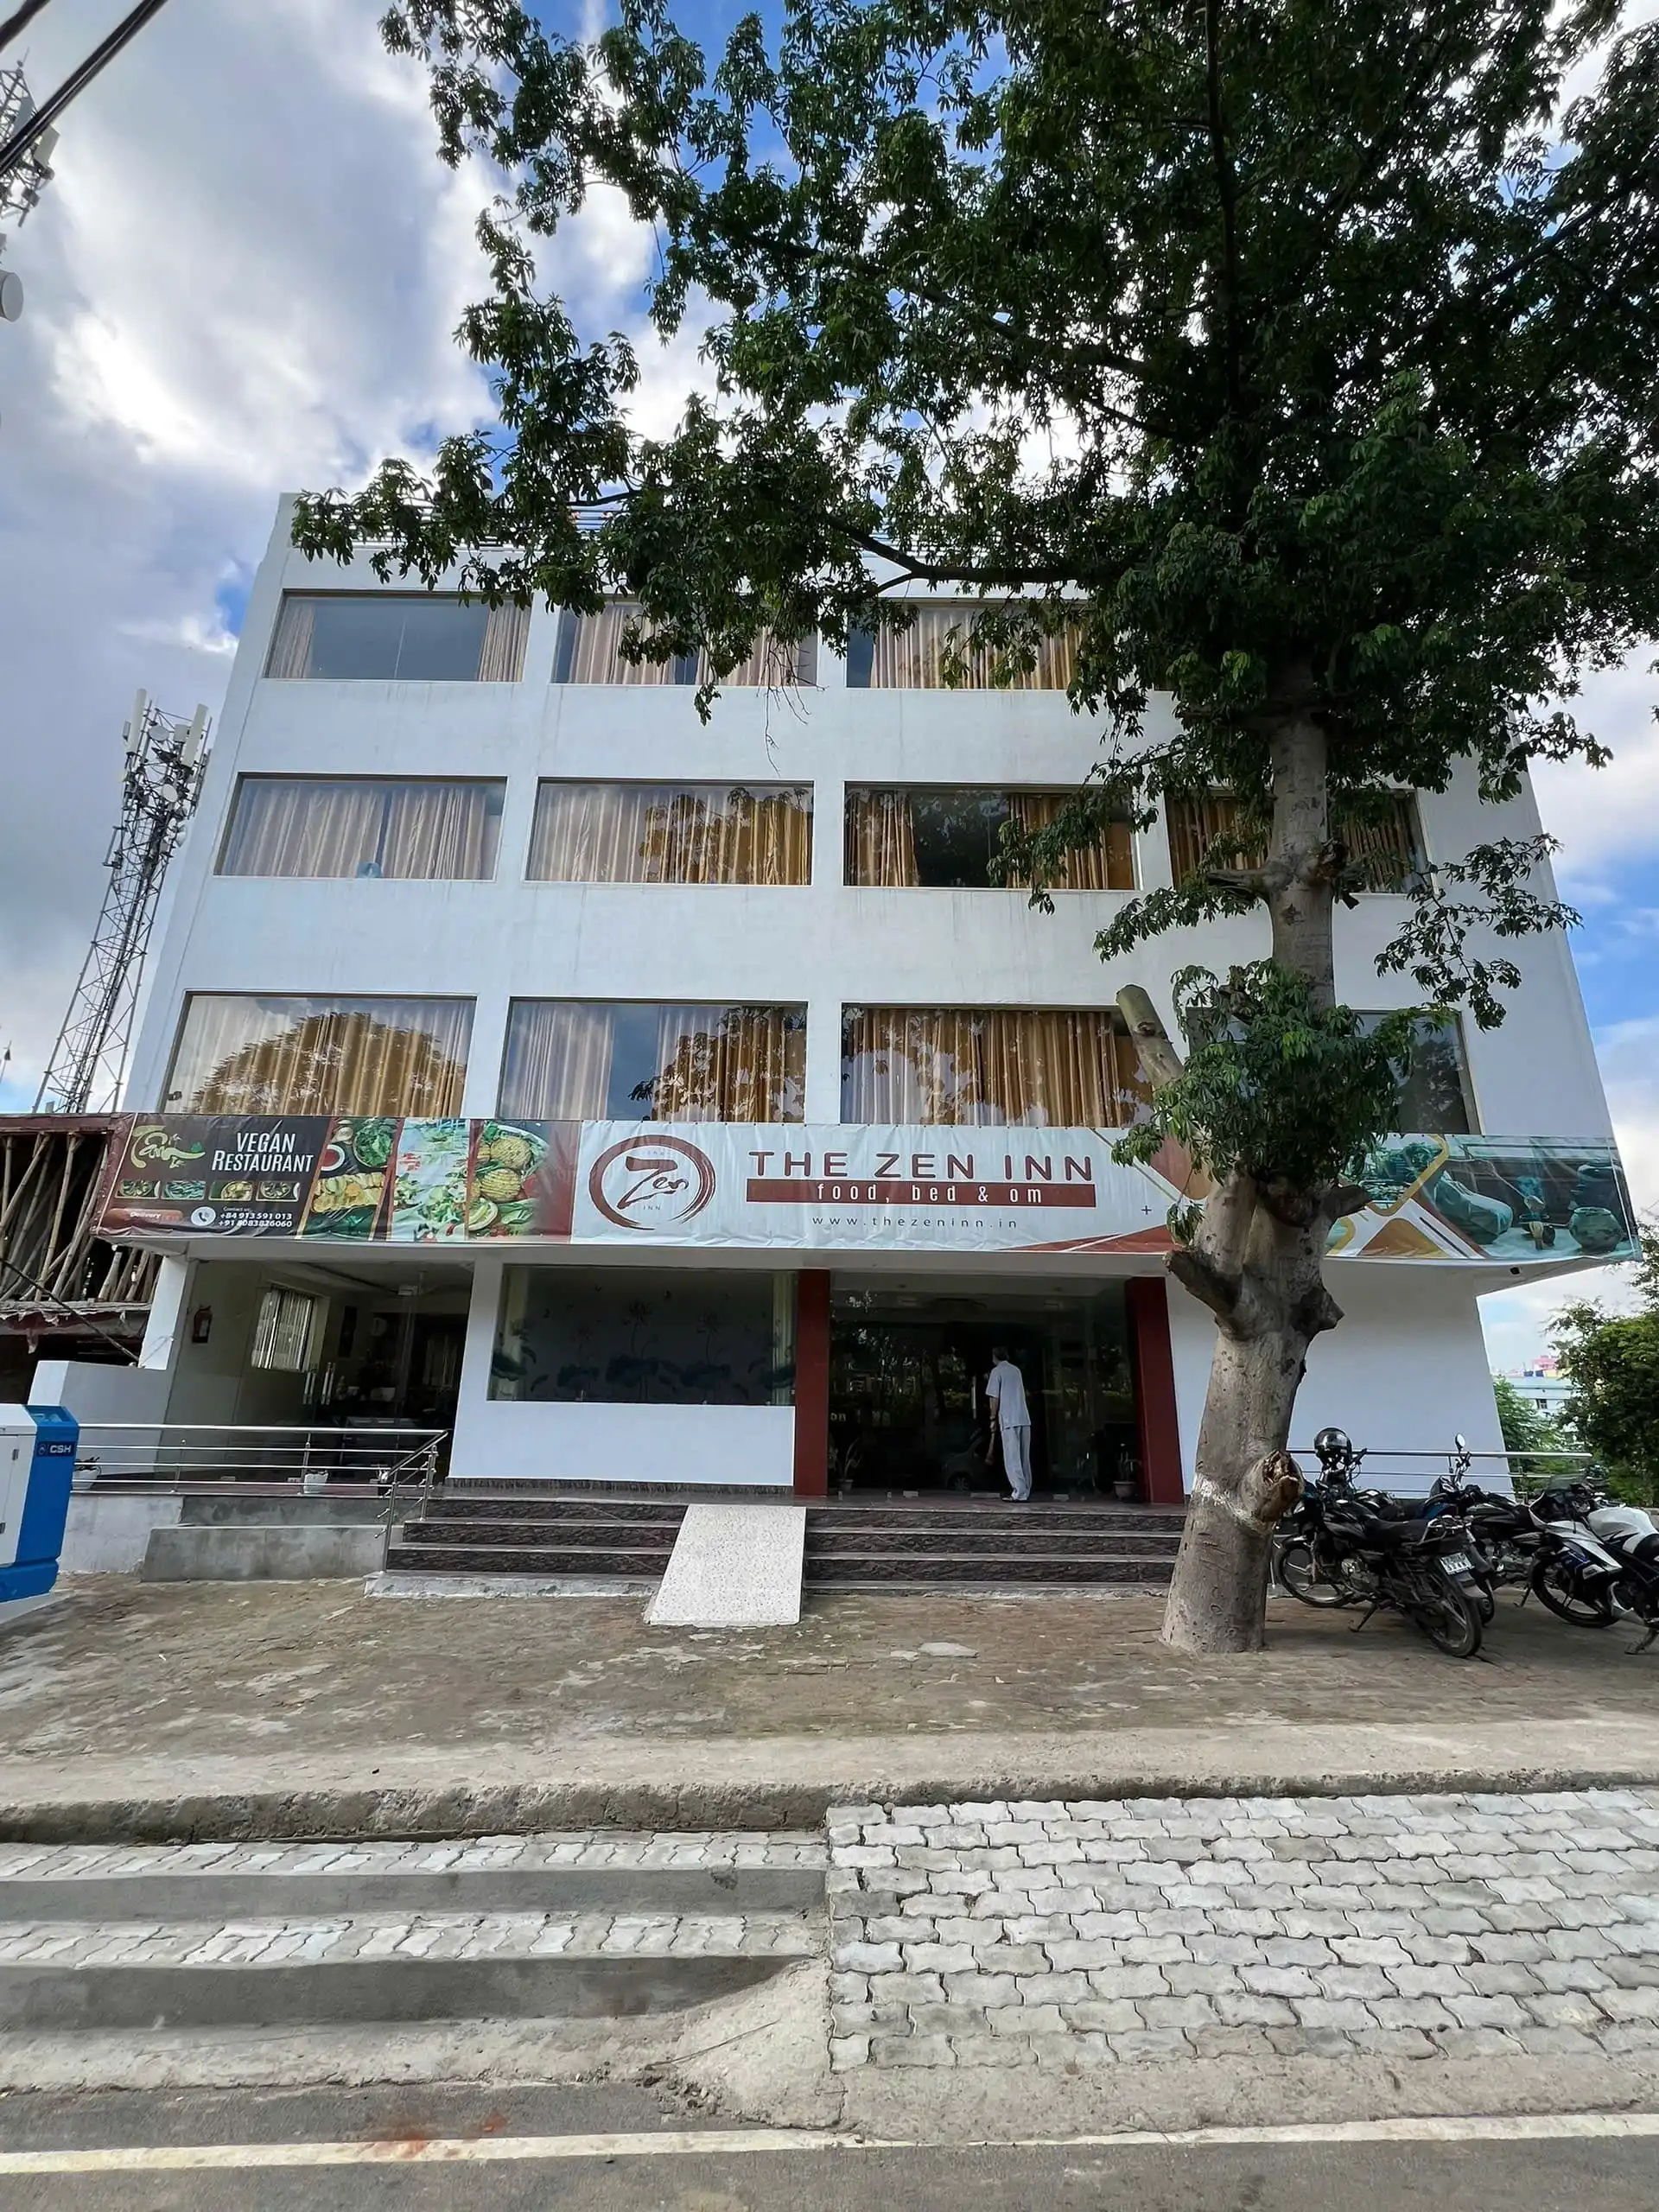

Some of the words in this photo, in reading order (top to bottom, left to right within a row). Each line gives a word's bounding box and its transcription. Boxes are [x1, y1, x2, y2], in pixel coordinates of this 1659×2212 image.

[237, 1132, 296, 1153] VEGAN
[748, 1151, 849, 1178] THE
[874, 1153, 974, 1179] ZEN
[1004, 1154, 1092, 1181] INN
[617, 1155, 690, 1210] Zen
[817, 1183, 890, 1204] food,
[912, 1184, 956, 1202] bed
[977, 1185, 988, 1203] &
[1009, 1187, 1042, 1204] om
[812, 1216, 1017, 1229] www.thezeninn.in
[49, 1444, 72, 1453] CSH
